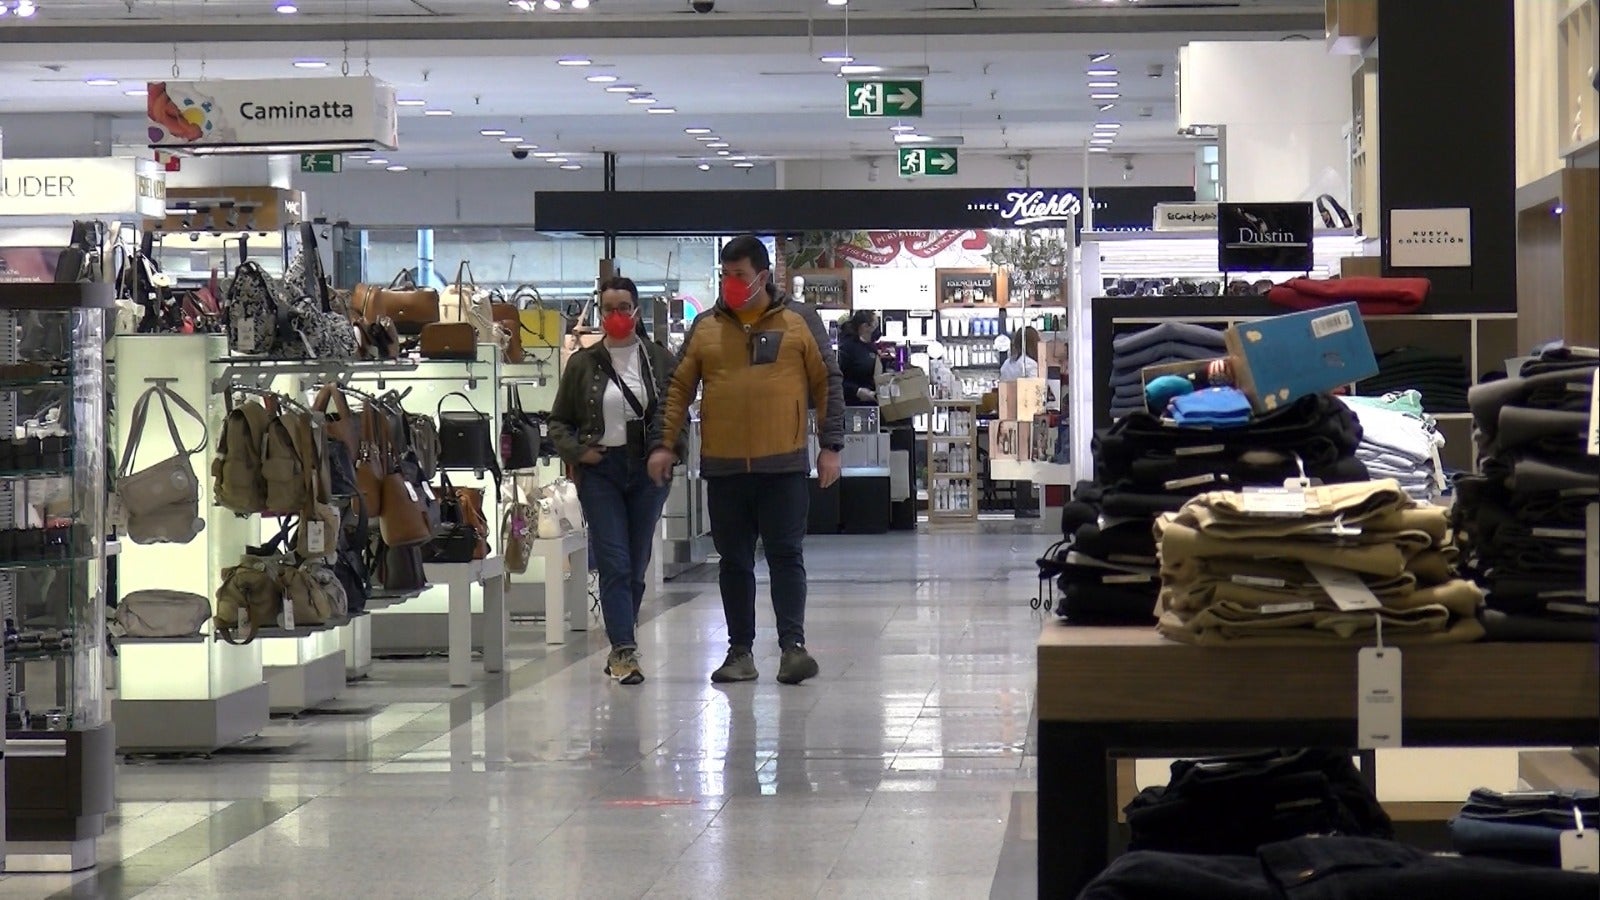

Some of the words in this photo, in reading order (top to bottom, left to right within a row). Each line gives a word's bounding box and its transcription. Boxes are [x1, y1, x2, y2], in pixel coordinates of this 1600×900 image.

[240, 101, 353, 120] Caminatta
[0, 175, 76, 197] UDER
[1000, 191, 1081, 219] Kiehl's
[1239, 227, 1294, 243] Dustin
